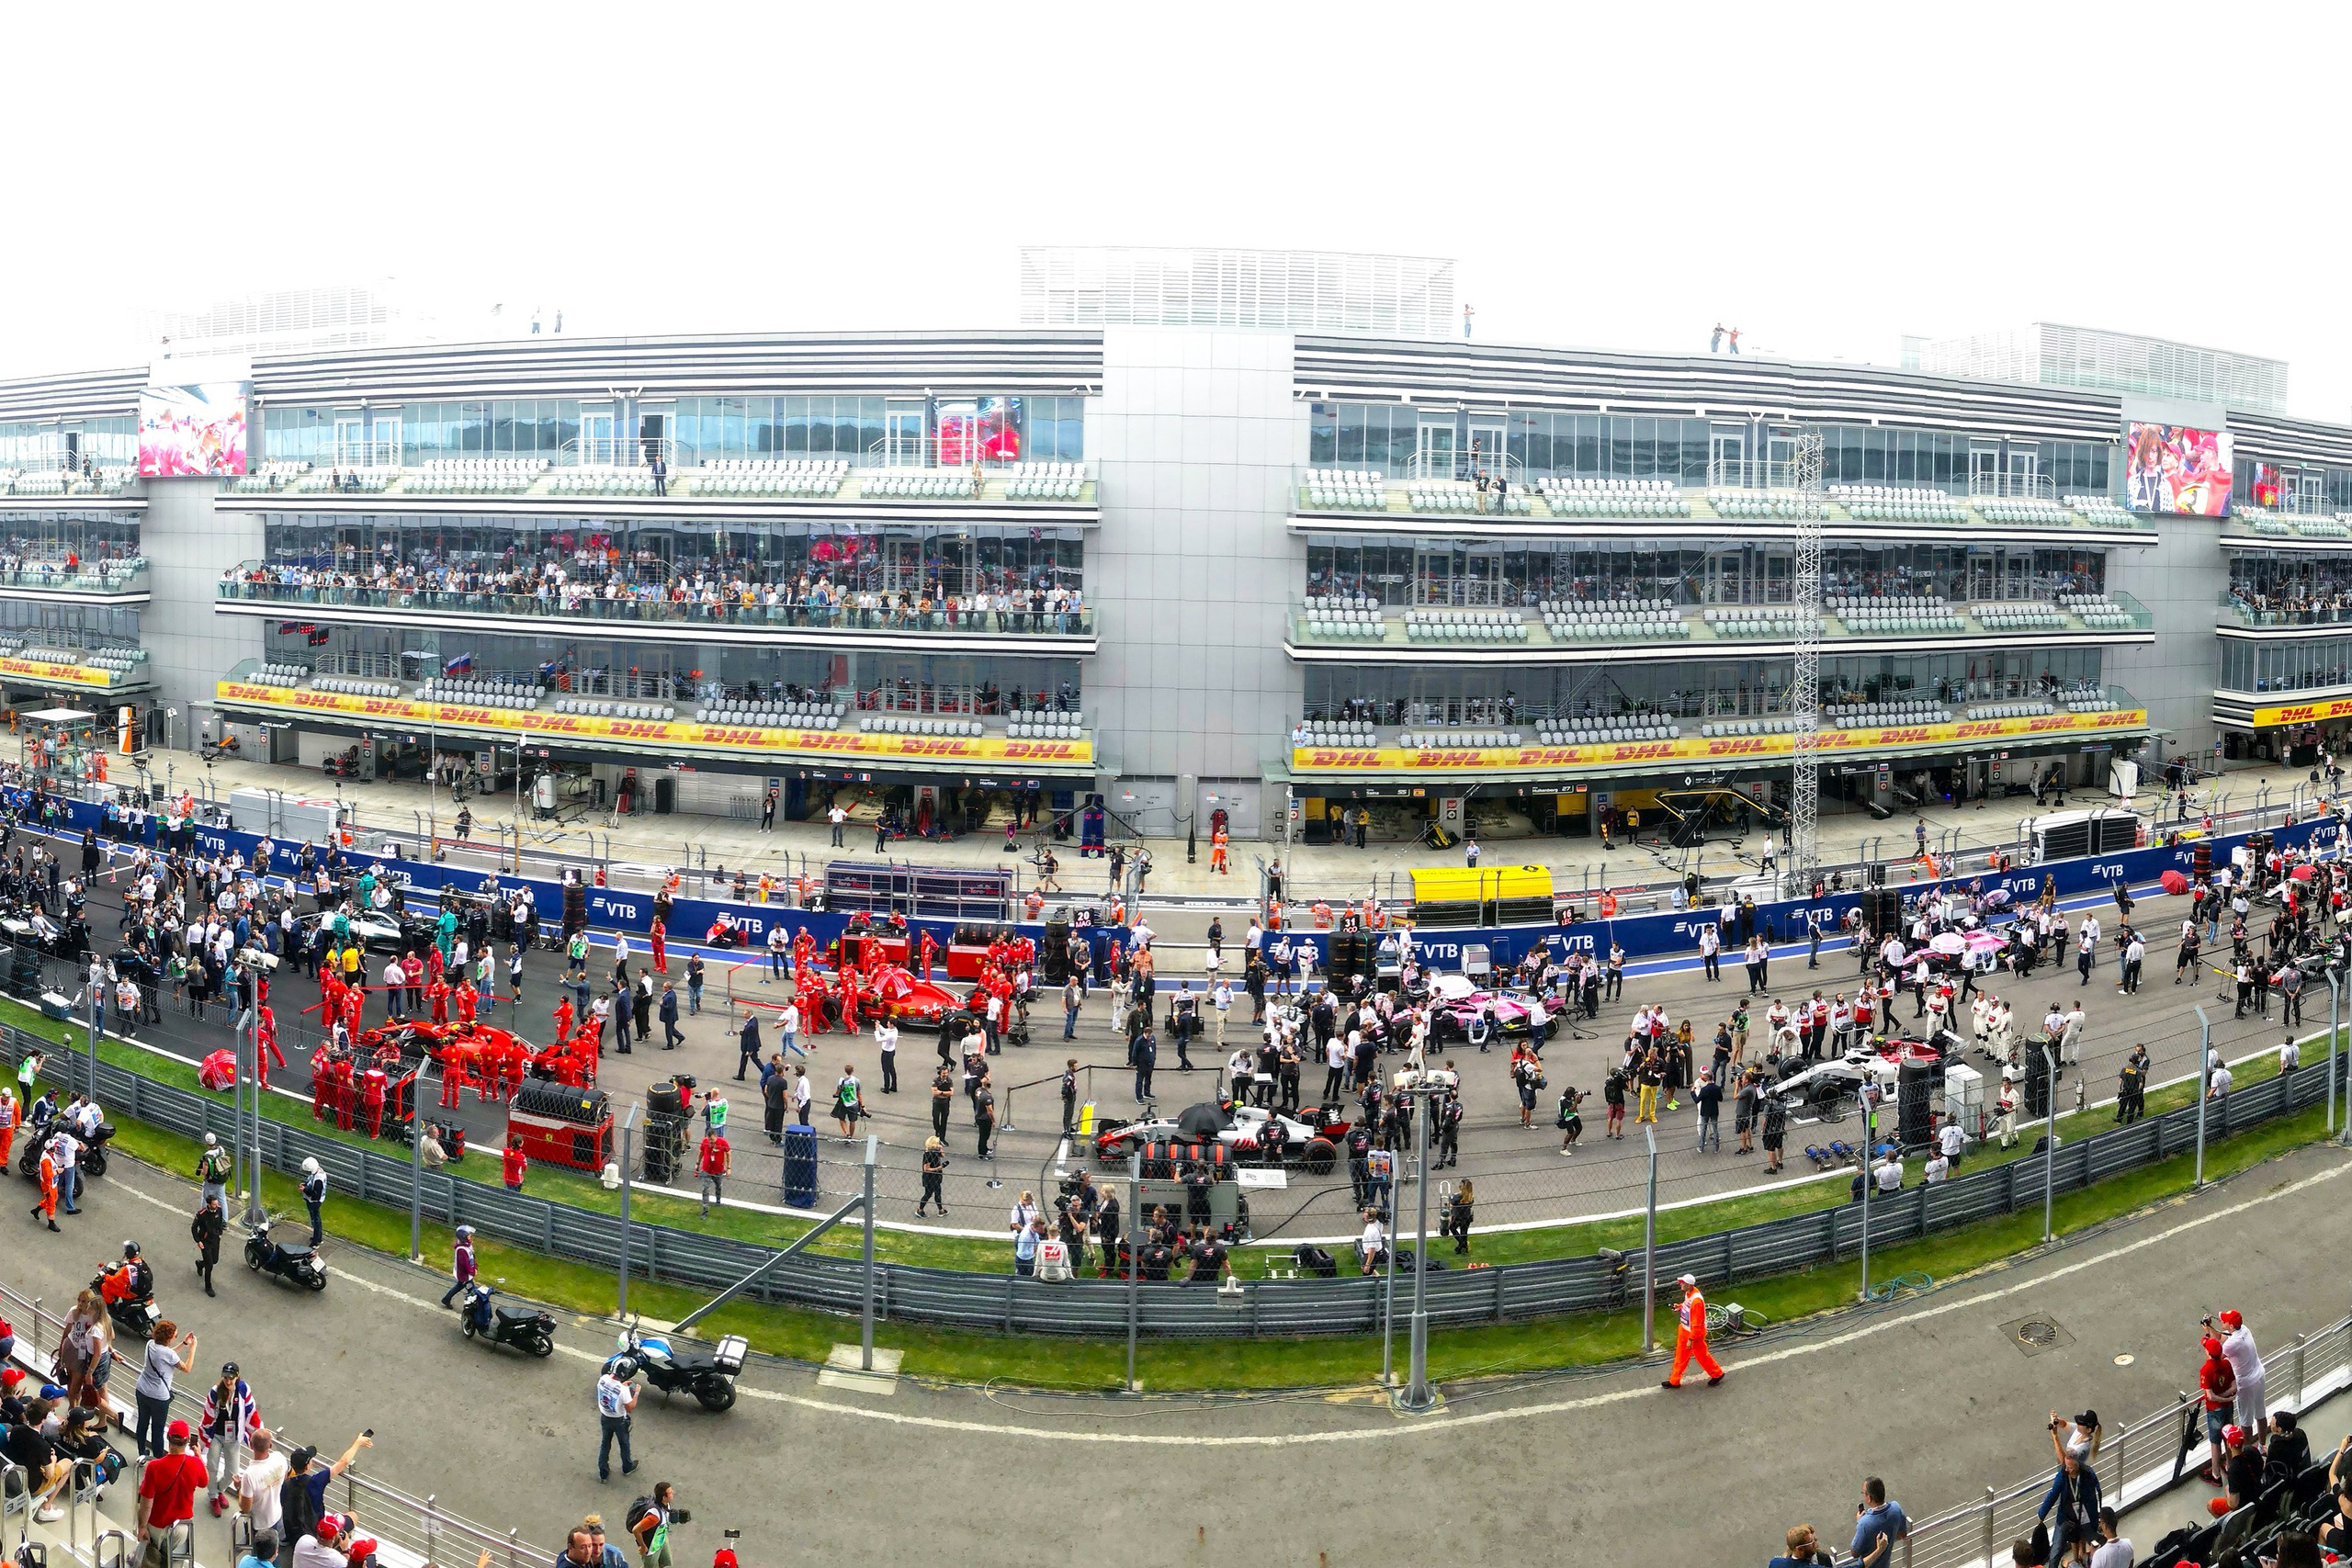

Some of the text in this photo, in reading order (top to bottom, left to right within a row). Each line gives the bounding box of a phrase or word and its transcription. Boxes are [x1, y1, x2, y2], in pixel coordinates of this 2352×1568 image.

[2, 660, 34, 673] DHL
[50, 666, 84, 680] DHL
[228, 685, 272, 701] DHL
[294, 693, 341, 708] DHL
[365, 700, 414, 716] DHL
[440, 707, 497, 724] DHL
[2278, 707, 2316, 722] DHL
[258, 720, 288, 729] McLaren
[521, 715, 584, 732] DHL
[2029, 716, 2077, 732] DHL
[2097, 712, 2140, 727] DHL
[608, 722, 672, 739] DHL
[702, 728, 769, 746] DHL
[1880, 728, 1932, 744] DHL
[1955, 722, 2006, 738] DHL
[797, 733, 869, 751] DHL
[900, 739, 971, 756] DHL
[1708, 739, 1769, 755] DHL
[1004, 742, 1076, 759] DHL
[1312, 750, 1383, 767] DHL
[1518, 749, 1584, 765] DHL
[1613, 744, 1677, 761] DHL
[1416, 751, 1486, 767] DHL
[216, 816, 228, 825] 77
[2321, 826, 2337, 839] VTB
[204, 836, 226, 851] VTB
[382, 844, 396, 854] 44
[2102, 863, 2124, 879] VTB
[1815, 883, 1823, 892] 11
[2012, 877, 2036, 894] VTB
[812, 905, 825, 913] RAI
[814, 897, 821, 906] 7
[606, 902, 637, 919] VTB
[1078, 910, 1091, 921] 20
[1562, 908, 1572, 919] 16
[731, 917, 763, 933] VTB
[1075, 919, 1091, 928] MAG
[1345, 918, 1356, 928] 31
[1562, 918, 1573, 926] LEC
[1562, 934, 1594, 951] VTB
[1425, 943, 1458, 959] VTB
[1500, 990, 1526, 1001] BWT 31
[1293, 1113, 1302, 1123] 20
[6, 1502, 14, 1513] 3
